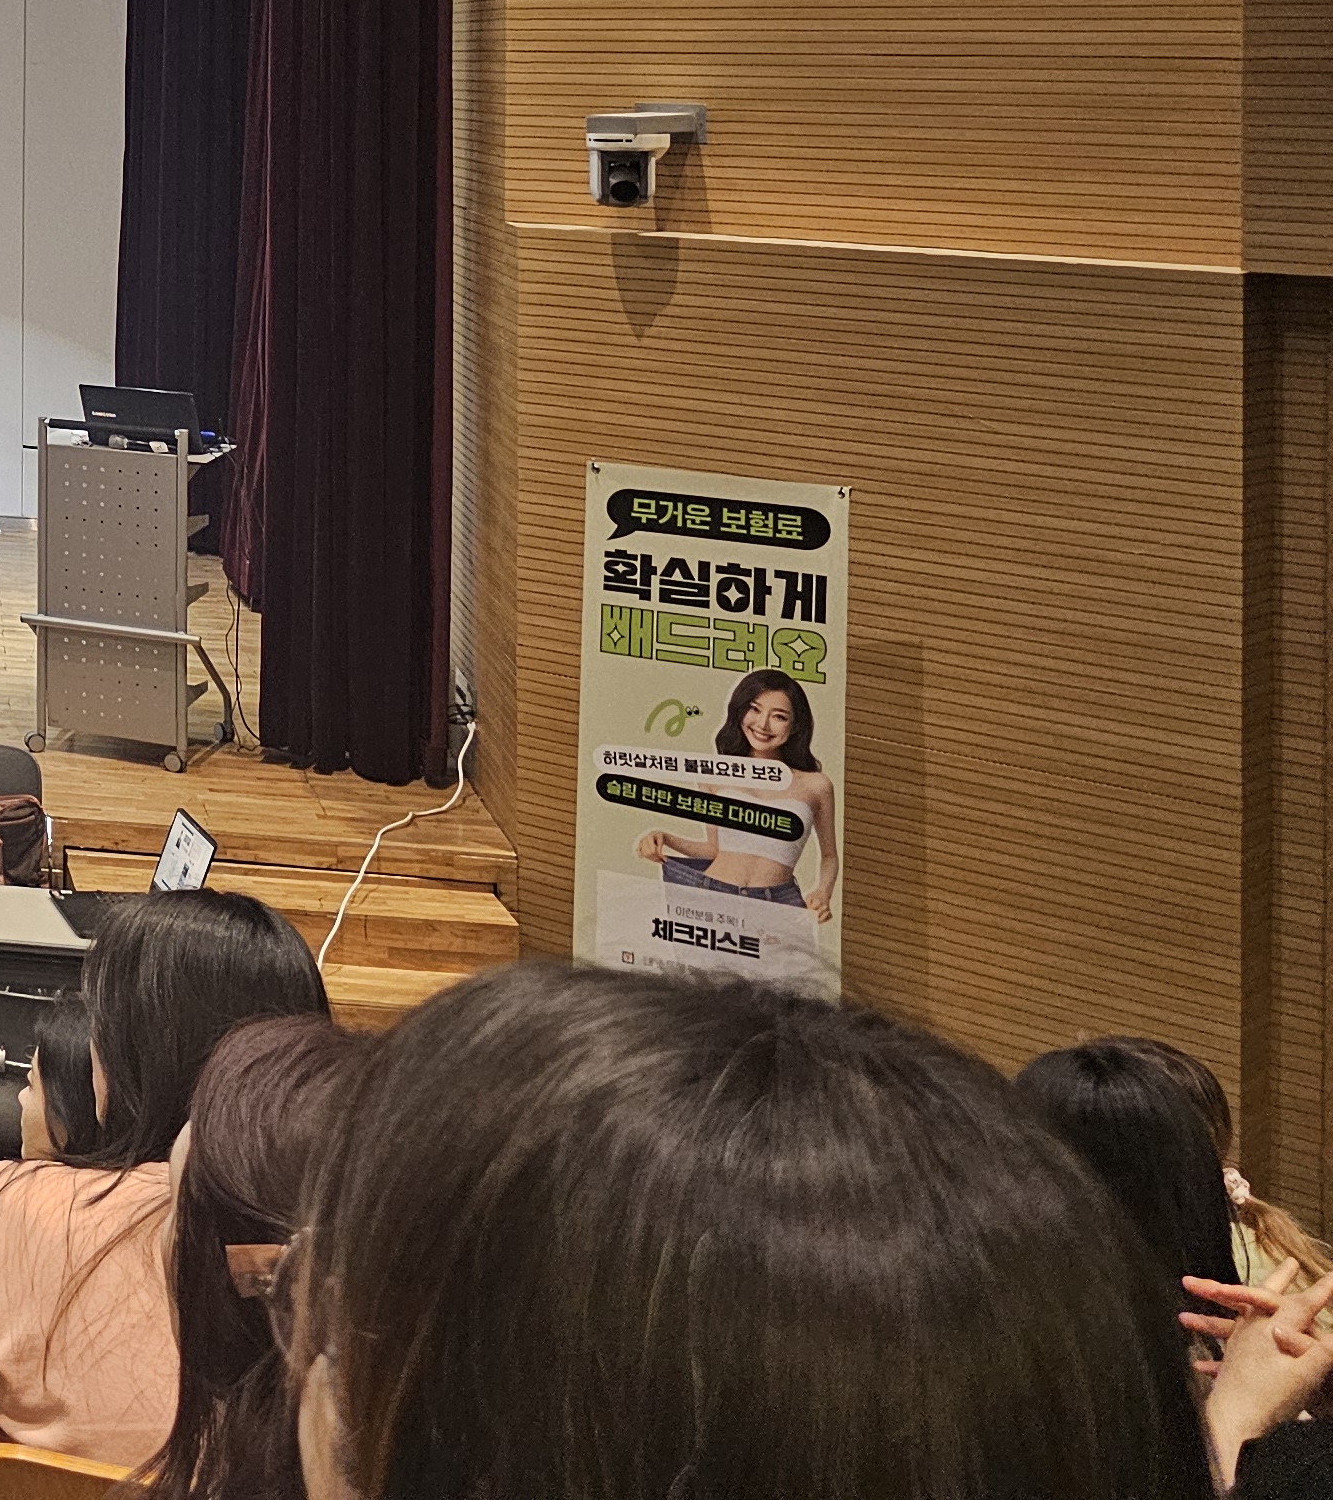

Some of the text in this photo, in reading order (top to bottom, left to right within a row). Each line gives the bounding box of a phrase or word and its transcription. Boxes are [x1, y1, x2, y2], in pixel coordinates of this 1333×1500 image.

[631, 497, 805, 540] 무거운 보험료
[603, 548, 828, 624] 확실하게
[600, 603, 828, 685] 빼드려요
[602, 749, 783, 783] 허릿살처럼 불필요한 보장
[606, 780, 793, 834] 슬림 탄탄 보험료 다이어트
[675, 904, 714, 923] 이런분들
[651, 917, 761, 959] 체크리스트
